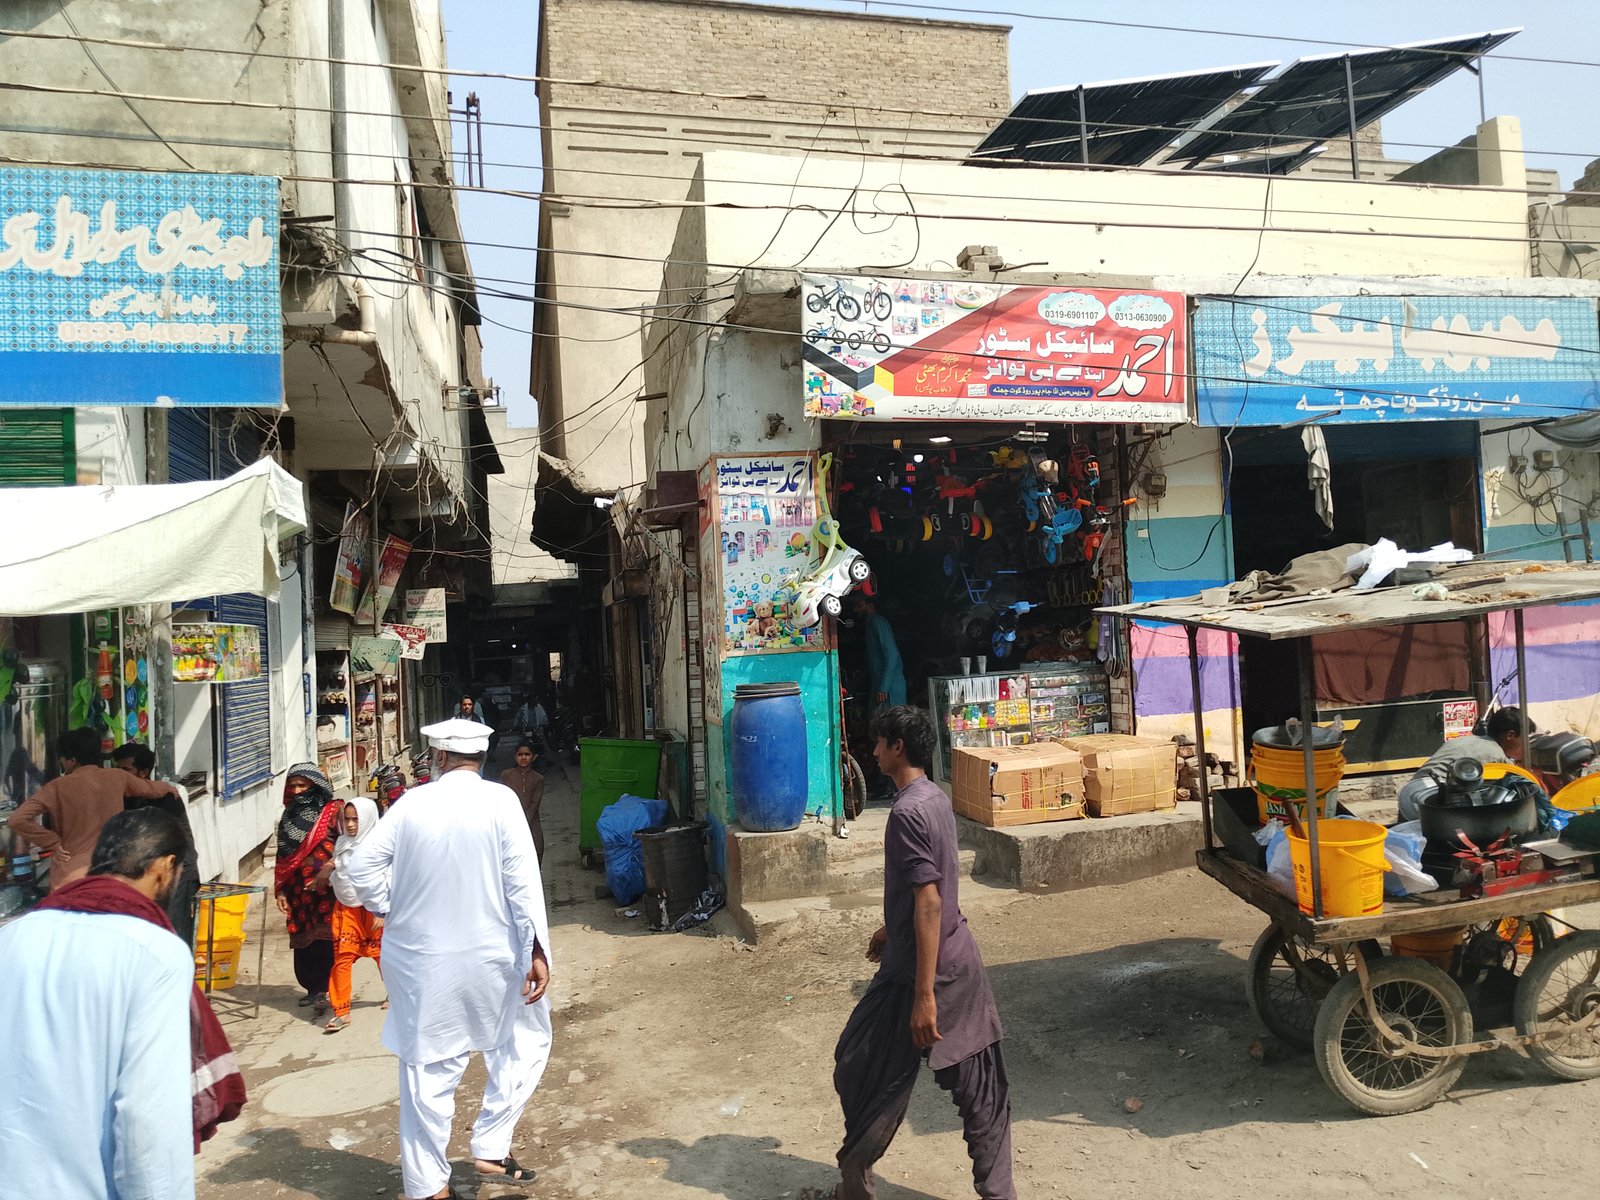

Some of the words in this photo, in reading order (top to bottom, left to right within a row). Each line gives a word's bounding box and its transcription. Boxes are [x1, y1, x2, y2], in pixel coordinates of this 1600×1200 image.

[1045, 310, 1099, 320] 0319-6901107
[976, 326, 1031, 355] سٹور
[1036, 330, 1115, 358] سائیکل
[1242, 302, 1394, 376] بیکرز
[1401, 313, 1561, 372] محبوب
[1097, 328, 1175, 398] احمد
[1390, 387, 1439, 414] کوٹ
[1439, 385, 1471, 412] روڈ
[1471, 391, 1521, 412] مین
[744, 460, 785, 475] سائیکل
[775, 458, 813, 494] احمد
